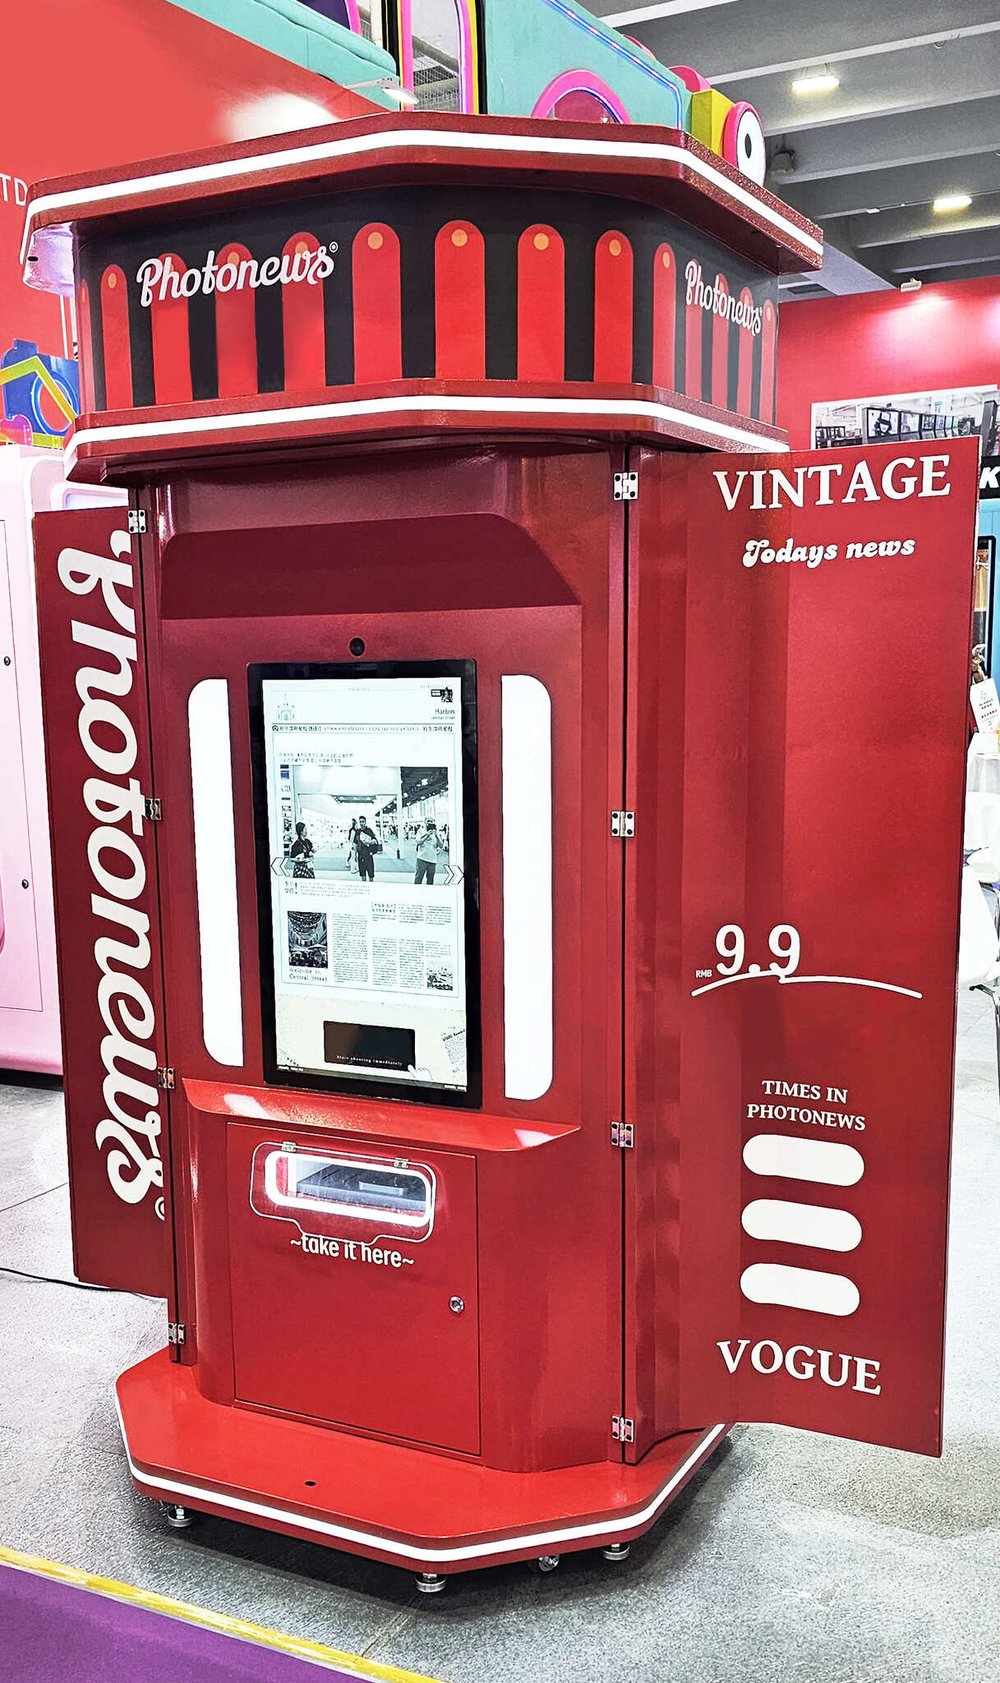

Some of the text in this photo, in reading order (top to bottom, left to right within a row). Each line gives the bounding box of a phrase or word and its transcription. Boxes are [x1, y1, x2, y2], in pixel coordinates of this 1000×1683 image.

[713, 455, 950, 511] VINTAGE
[742, 538, 916, 568] Todays news
[715, 924, 801, 977] 9.9
[695, 969, 713, 978] RMB
[762, 1080, 848, 1103] TIMES IN
[747, 1103, 866, 1131] PHOTONEWS
[344, 1241, 357, 1261] it
[716, 1340, 882, 1396] VOGUE
